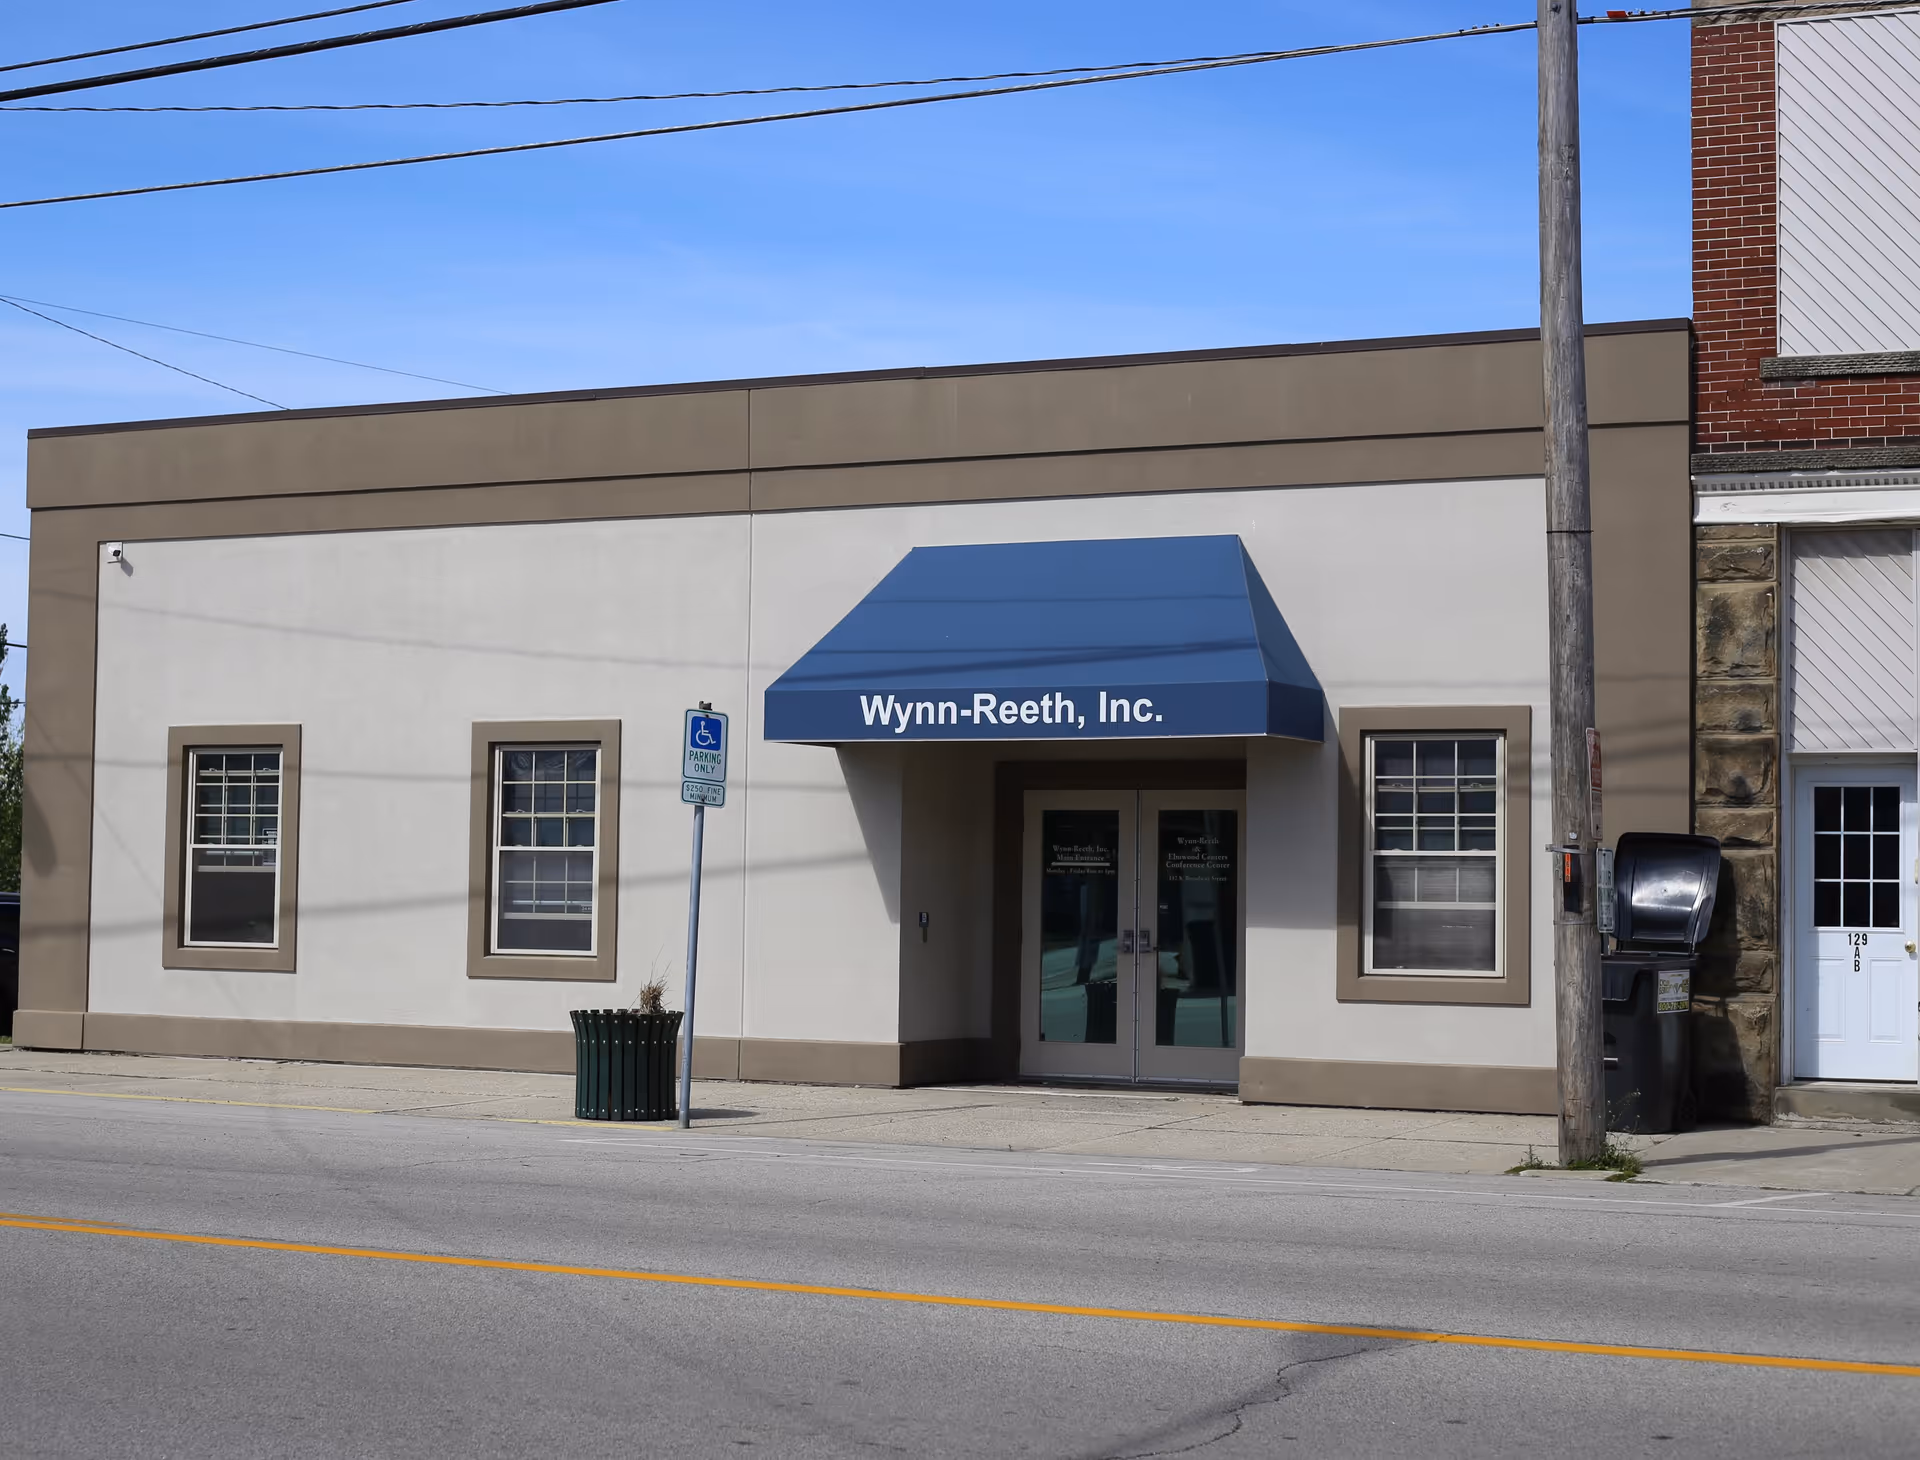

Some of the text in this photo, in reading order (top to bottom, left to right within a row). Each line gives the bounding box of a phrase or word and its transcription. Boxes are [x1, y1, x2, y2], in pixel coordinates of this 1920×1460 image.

[860, 691, 1163, 733] Wynn-Reeth, Inc.
[689, 750, 721, 764] PARKING
[694, 763, 715, 774] ONLY
[686, 784, 722, 796] $250 FINE
[1165, 861, 1205, 869] Conference
[1848, 933, 1868, 946] 129
[1854, 946, 1861, 959] A
[1854, 959, 1861, 972] B
